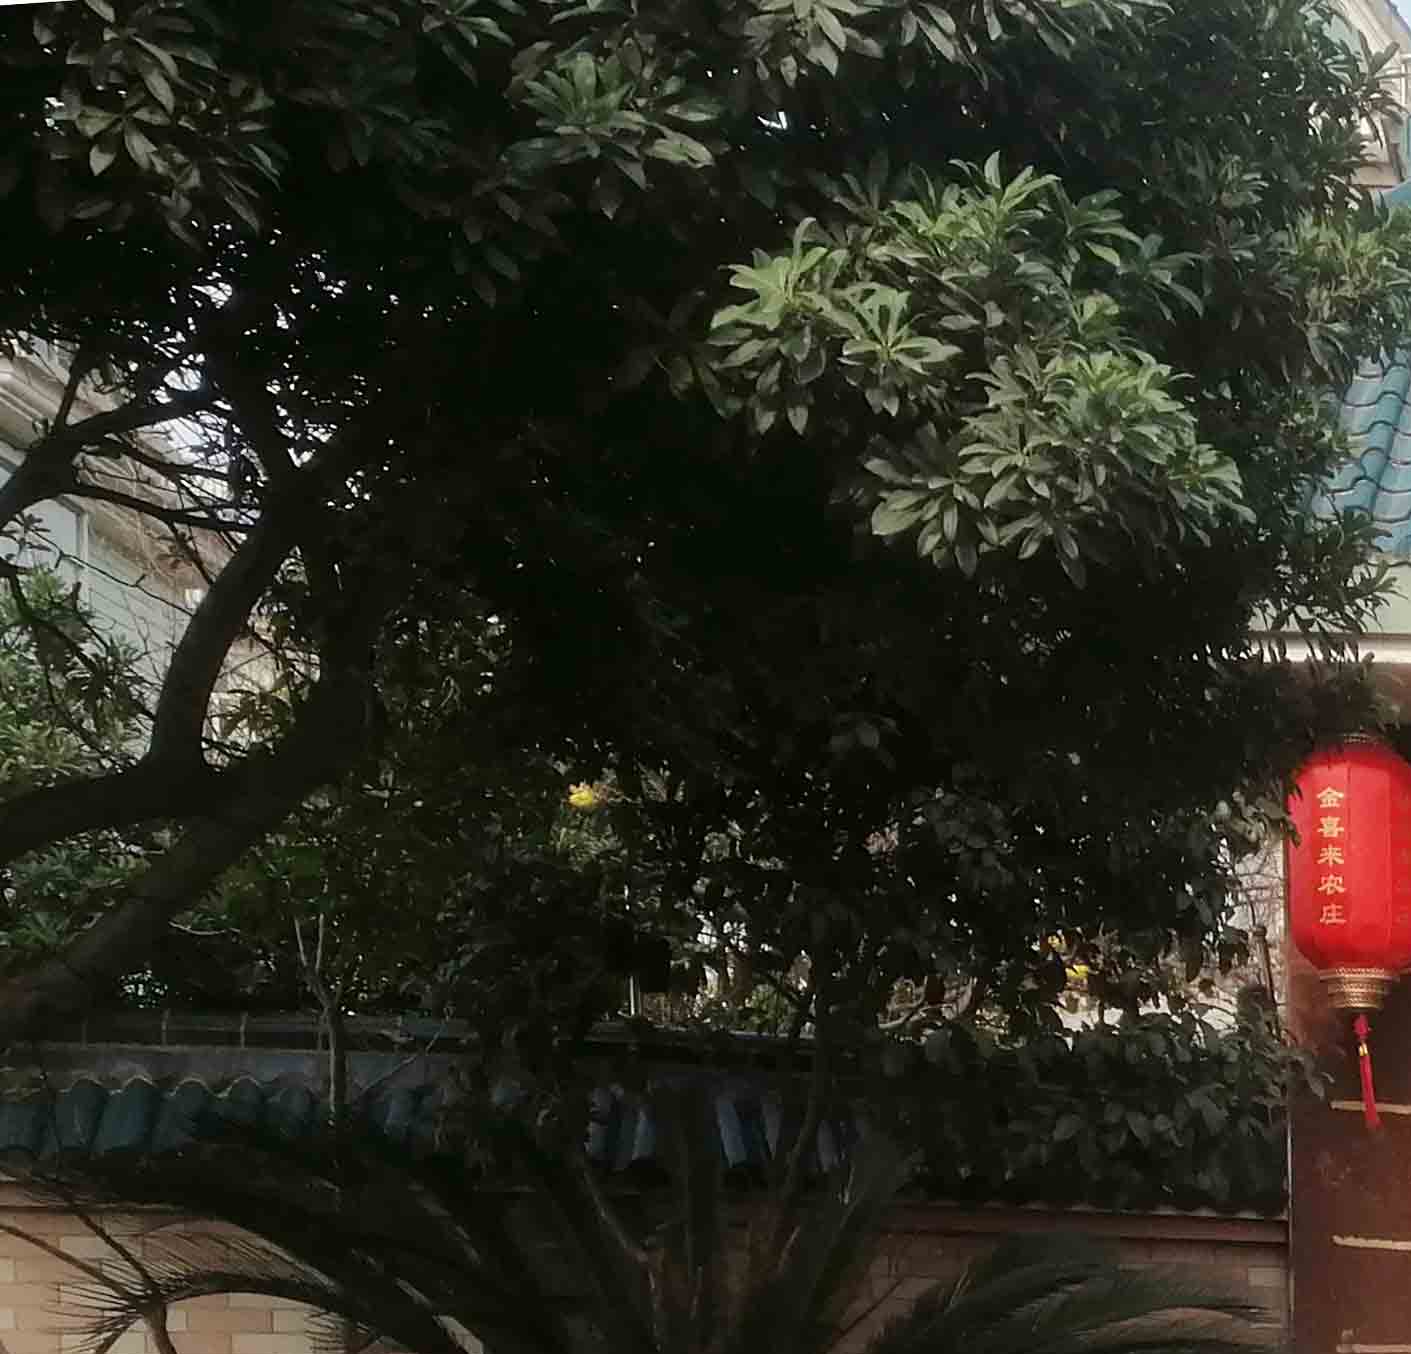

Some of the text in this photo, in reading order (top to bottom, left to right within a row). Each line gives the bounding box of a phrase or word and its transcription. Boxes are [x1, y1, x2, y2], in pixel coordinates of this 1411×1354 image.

[1315, 786, 1347, 926] 金喜来农庄
